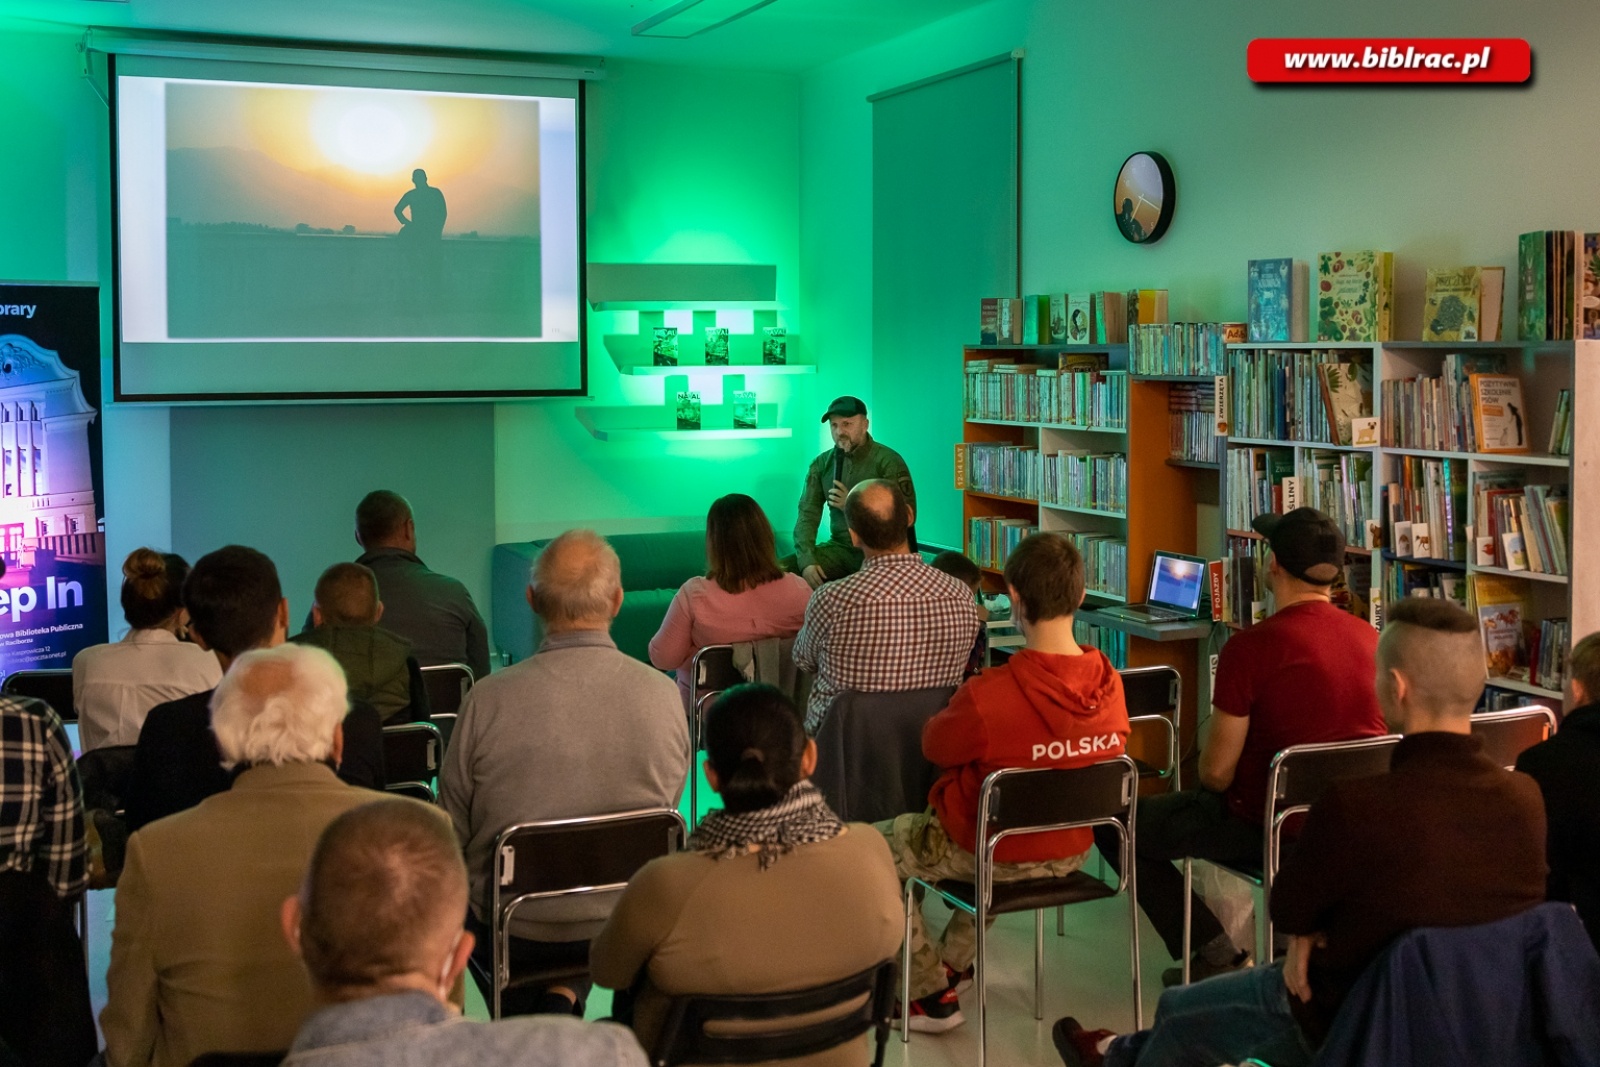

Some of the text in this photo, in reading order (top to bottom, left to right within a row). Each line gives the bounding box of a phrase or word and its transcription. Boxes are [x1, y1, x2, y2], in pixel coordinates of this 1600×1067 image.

[46, 576, 83, 610] In
[1212, 572, 1221, 609] POJAZDY
[5, 638, 34, 646] Raciborzu
[15, 627, 50, 637] Biblioteka
[50, 623, 84, 632] Publiczna
[1032, 731, 1121, 761] POLSKA
